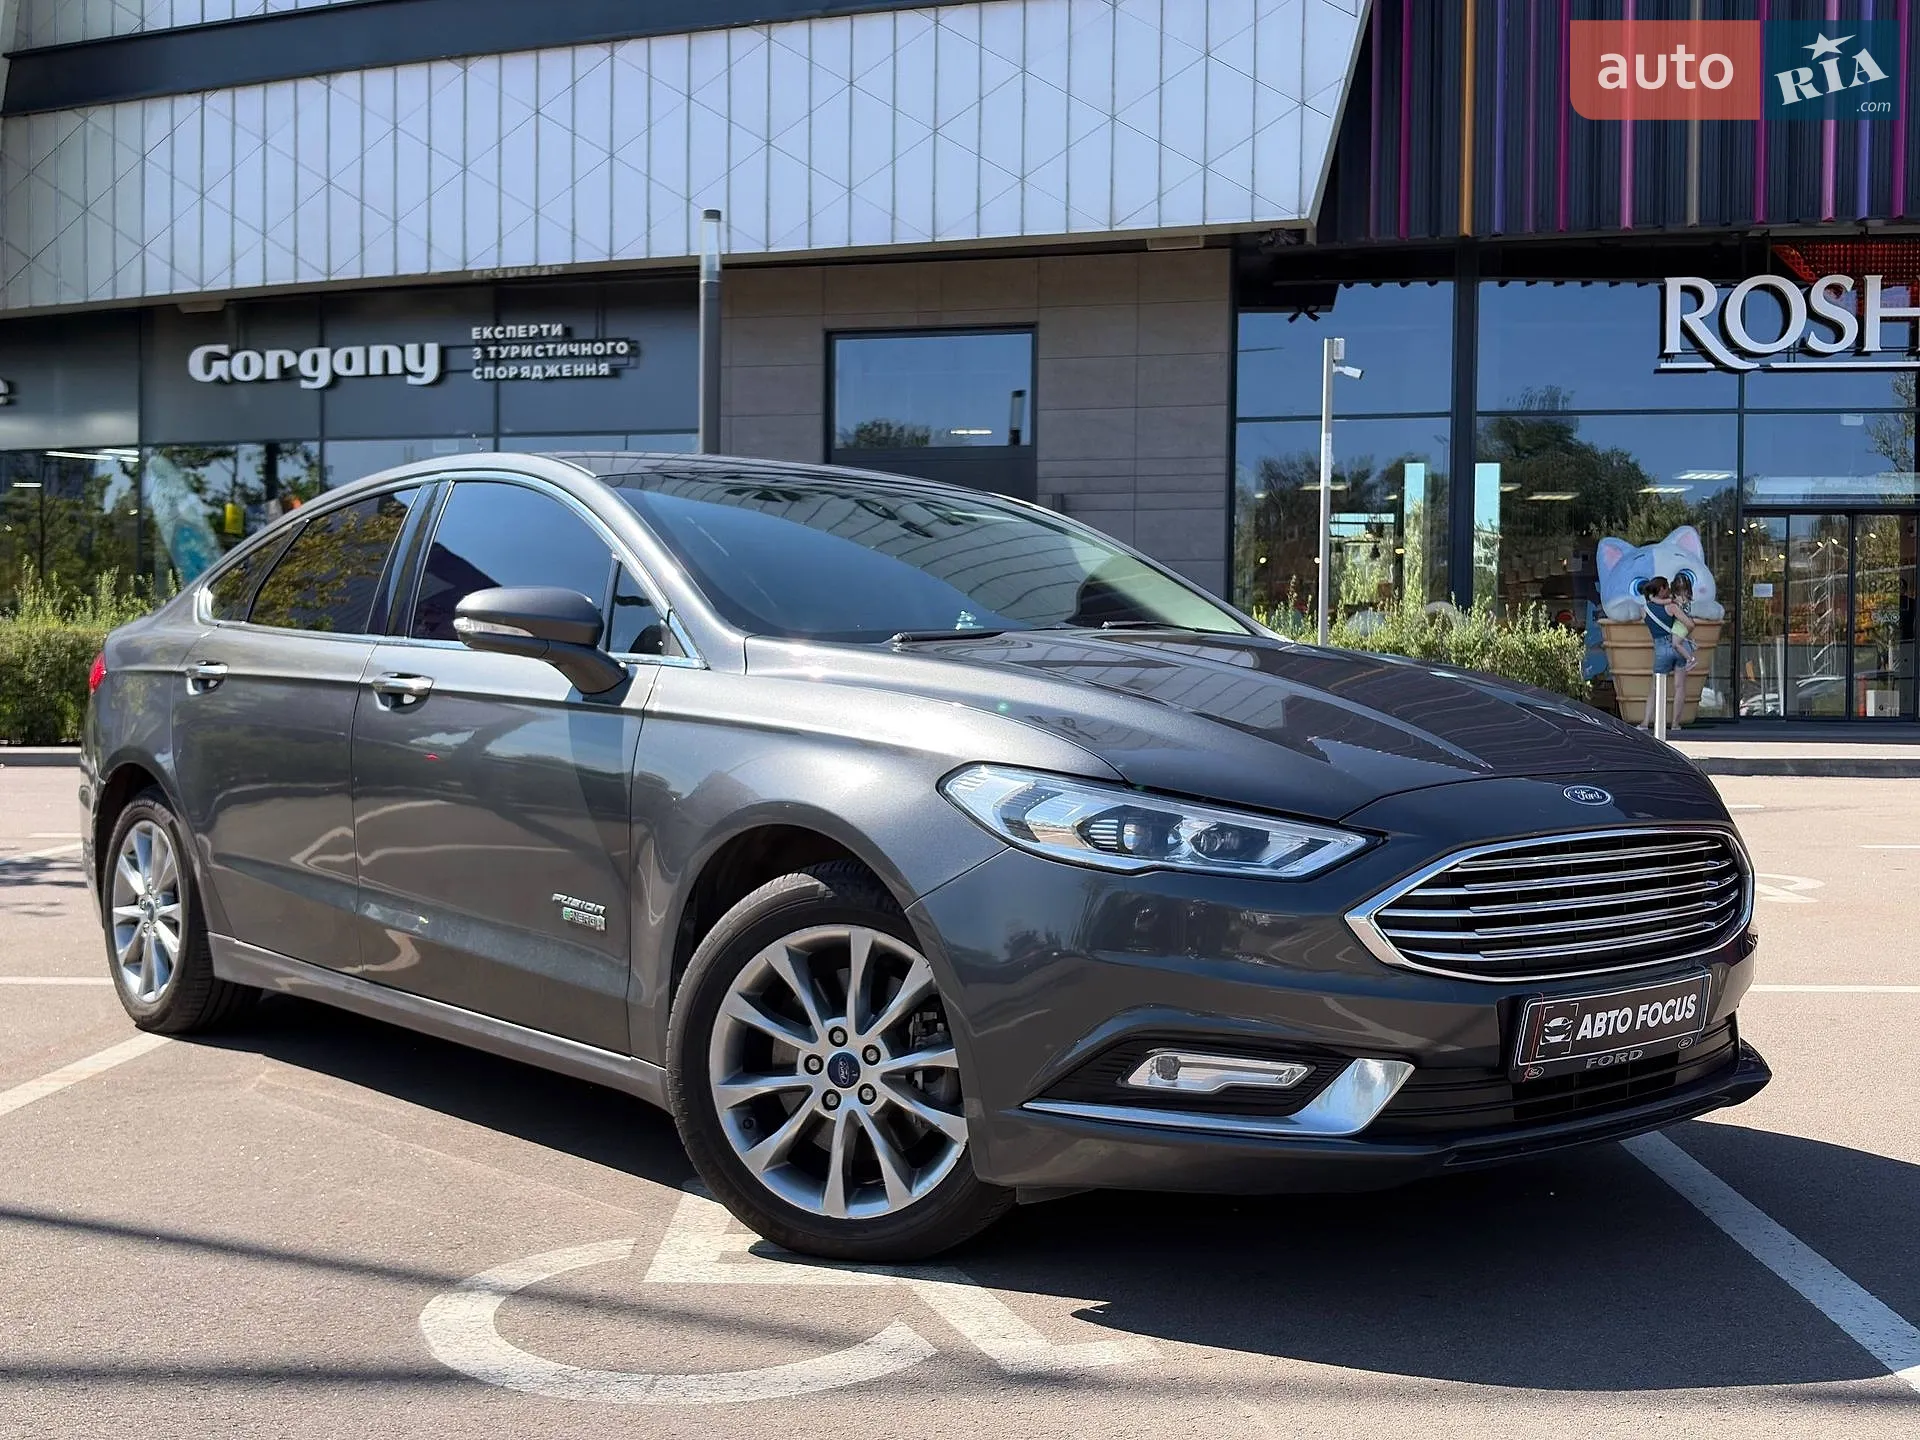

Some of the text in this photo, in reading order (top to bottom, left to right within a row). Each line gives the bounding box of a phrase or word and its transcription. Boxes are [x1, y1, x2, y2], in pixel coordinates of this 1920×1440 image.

[471, 323, 563, 340] ЕКСПЕРТИ
[1664, 274, 1920, 370] ROSH
[487, 341, 629, 360] ТУРИСТИЧНОГО
[188, 342, 440, 389] Gorgany
[472, 362, 611, 380] СПОРЯДЖЕННЯ
[1576, 993, 1697, 1041] АВТО FOCUS
[1586, 1049, 1644, 1069] FORD
